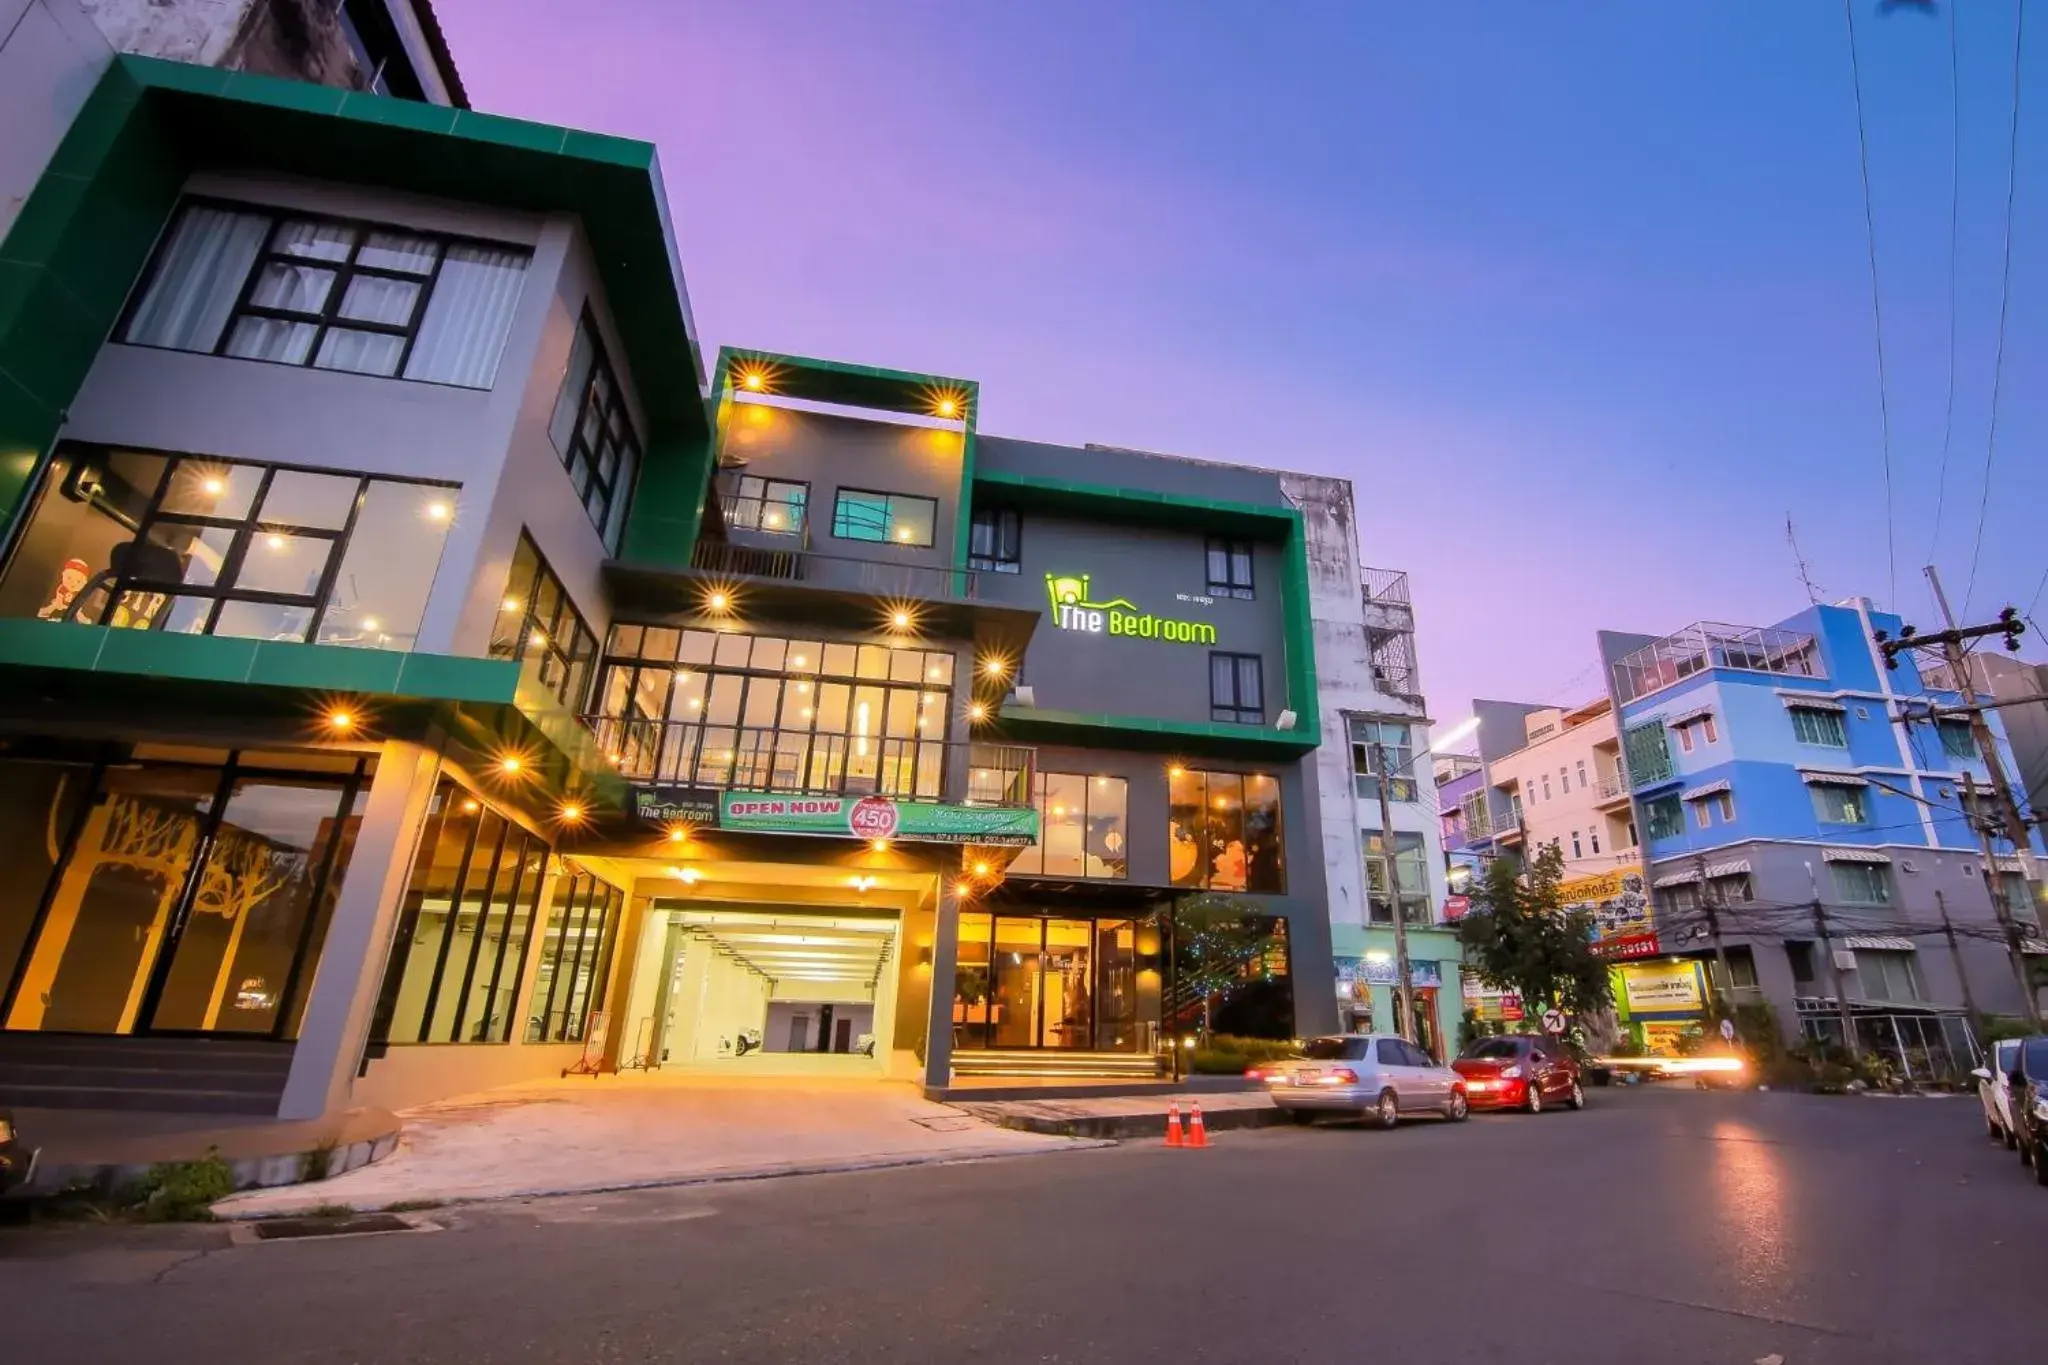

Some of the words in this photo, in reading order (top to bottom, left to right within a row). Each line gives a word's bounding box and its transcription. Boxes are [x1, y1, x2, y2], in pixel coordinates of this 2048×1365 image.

[1059, 606, 1102, 633] The
[1109, 611, 1216, 644] Bedroom
[639, 806, 660, 819] The
[662, 807, 713, 822] Bedroom
[730, 801, 785, 816] OPEN
[790, 800, 840, 814] NOW
[854, 809, 891, 828] 450
